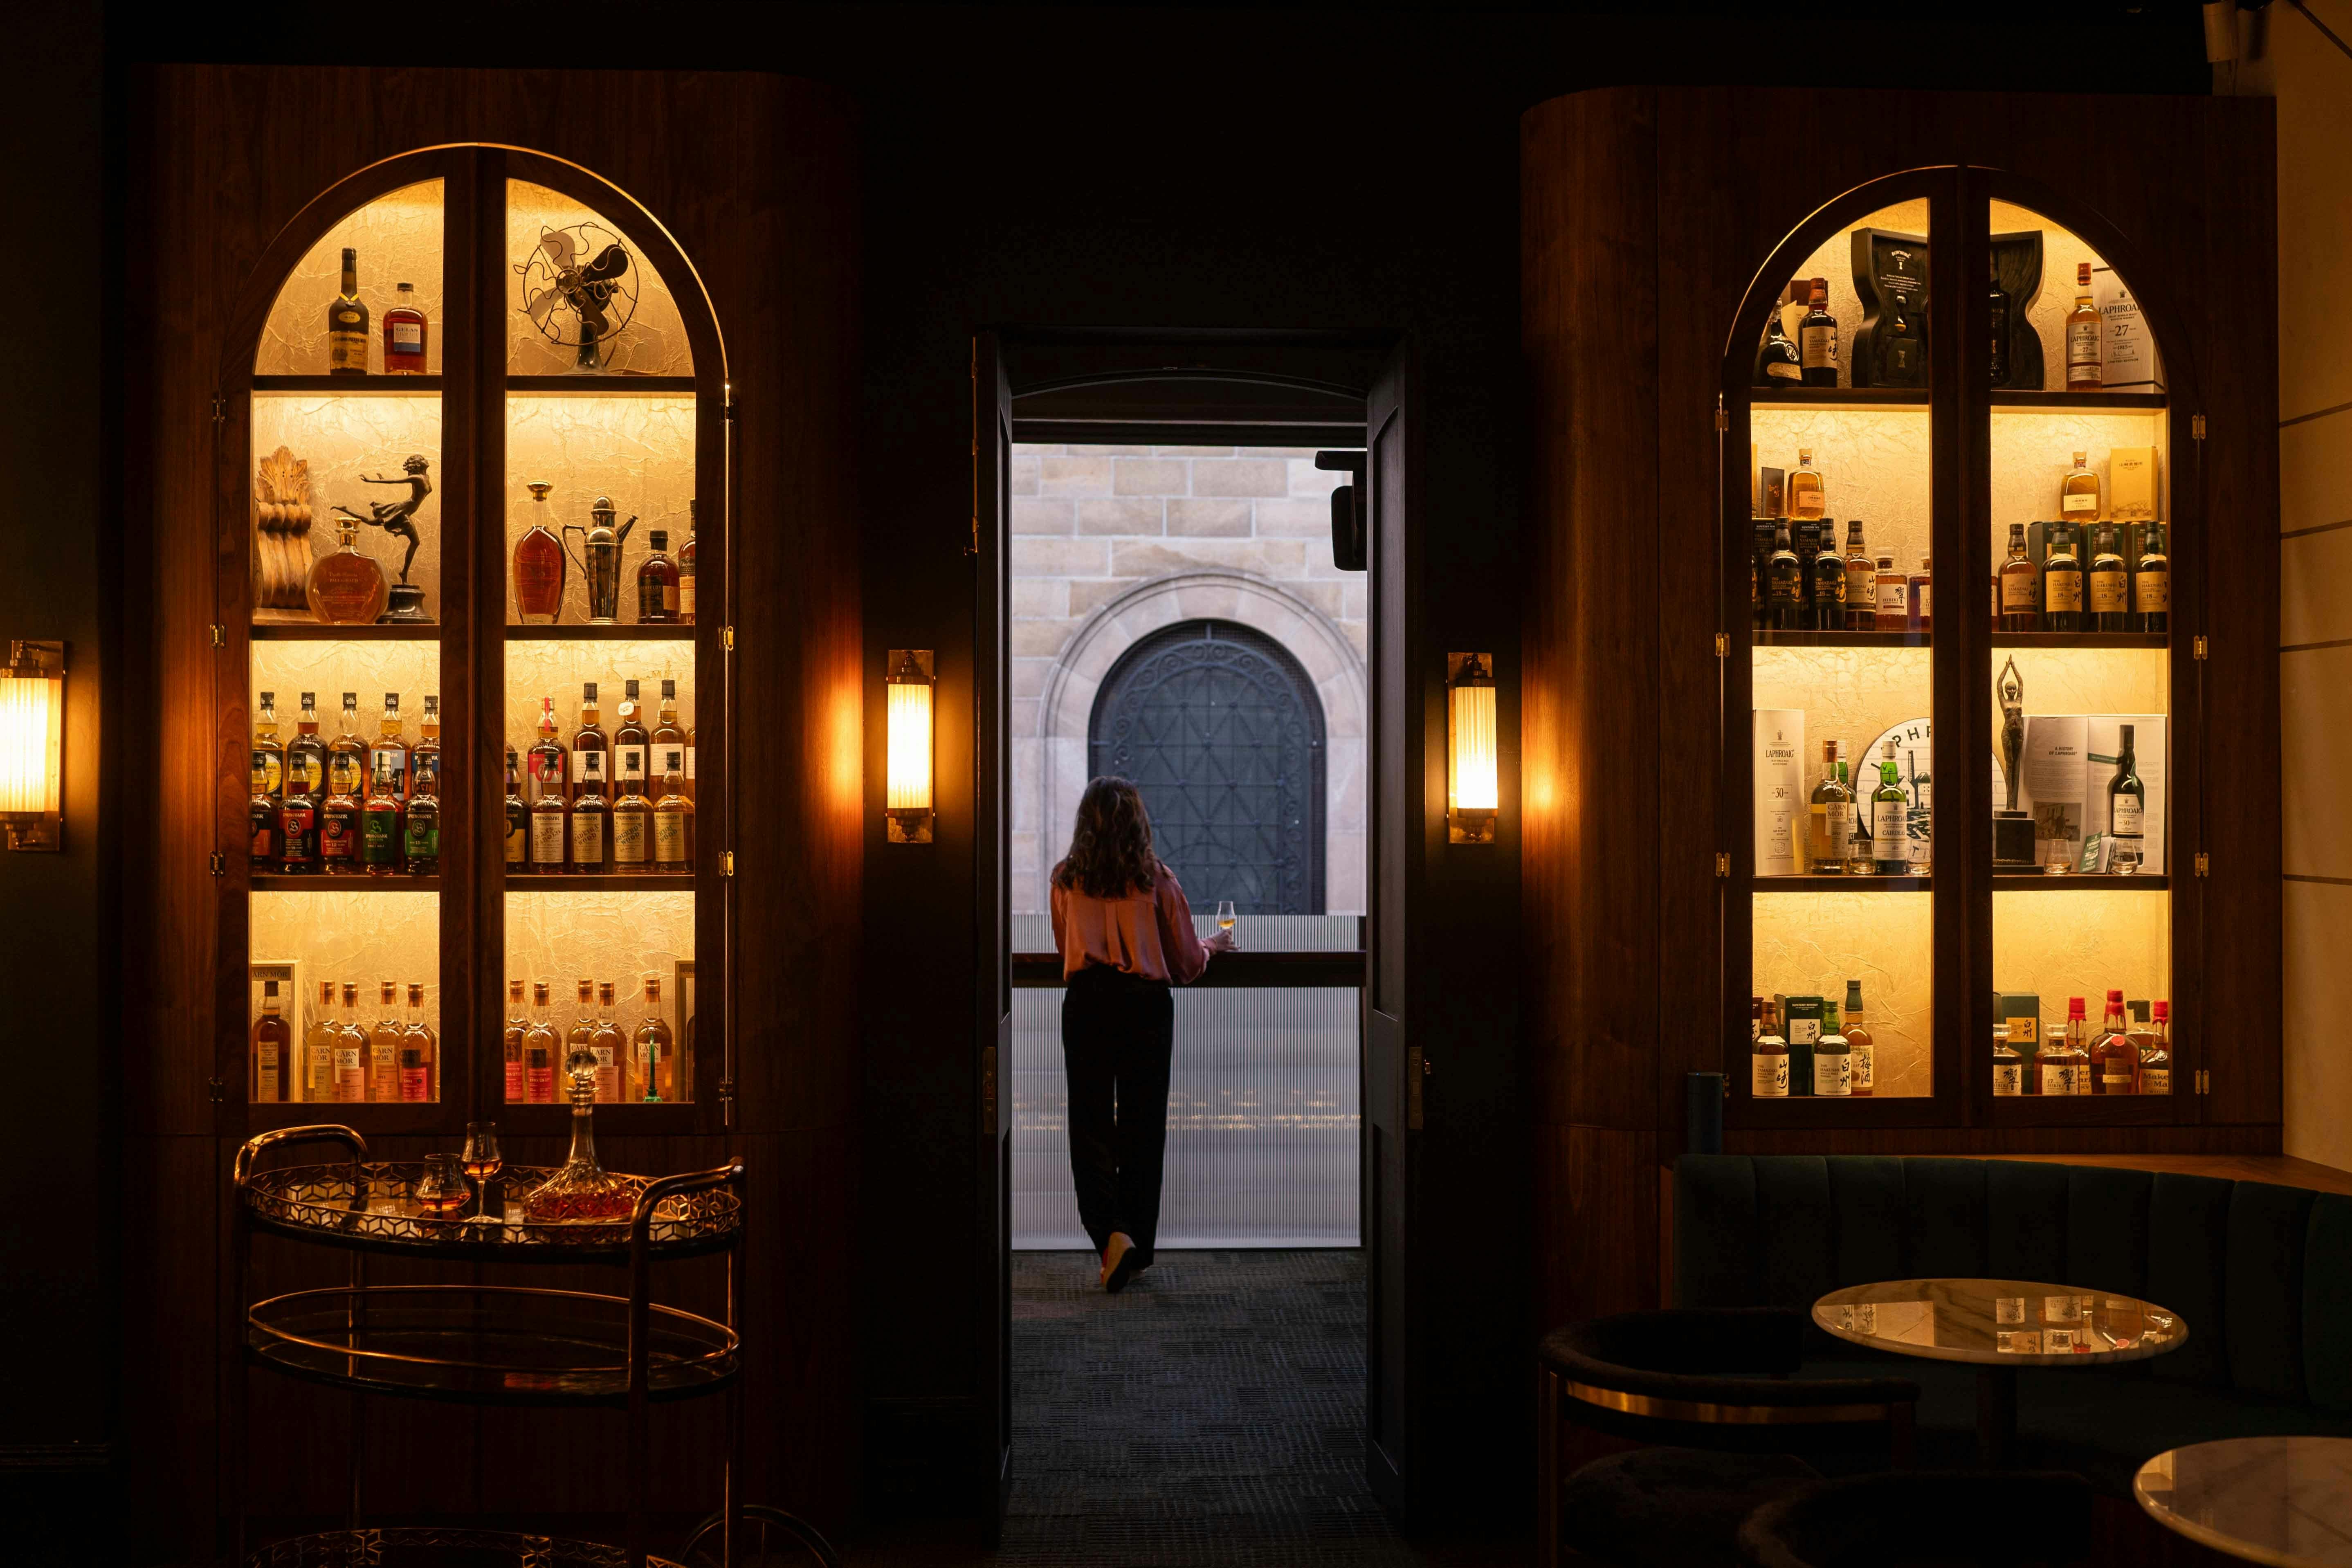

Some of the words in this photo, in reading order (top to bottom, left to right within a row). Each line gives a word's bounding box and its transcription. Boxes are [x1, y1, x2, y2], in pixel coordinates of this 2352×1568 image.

[2099, 304, 2139, 314] LAPHROA
[2114, 324, 2129, 337] 27
[2073, 575, 2082, 605] 白州
[2117, 575, 2127, 605] 白州
[1766, 750, 1794, 758] LAPHROAIG
[1775, 788, 1784, 798] 30
[578, 832, 597, 845] WOOD
[615, 823, 643, 841] BOURBON
[621, 832, 640, 845] WOOD
[660, 829, 677, 842] WOOD
[1807, 1022, 1816, 1040] 白州
[2023, 1020, 2032, 1038] 白州
[1840, 1058, 1850, 1089] 白州
[1860, 1054, 1871, 1085] 梅酒
